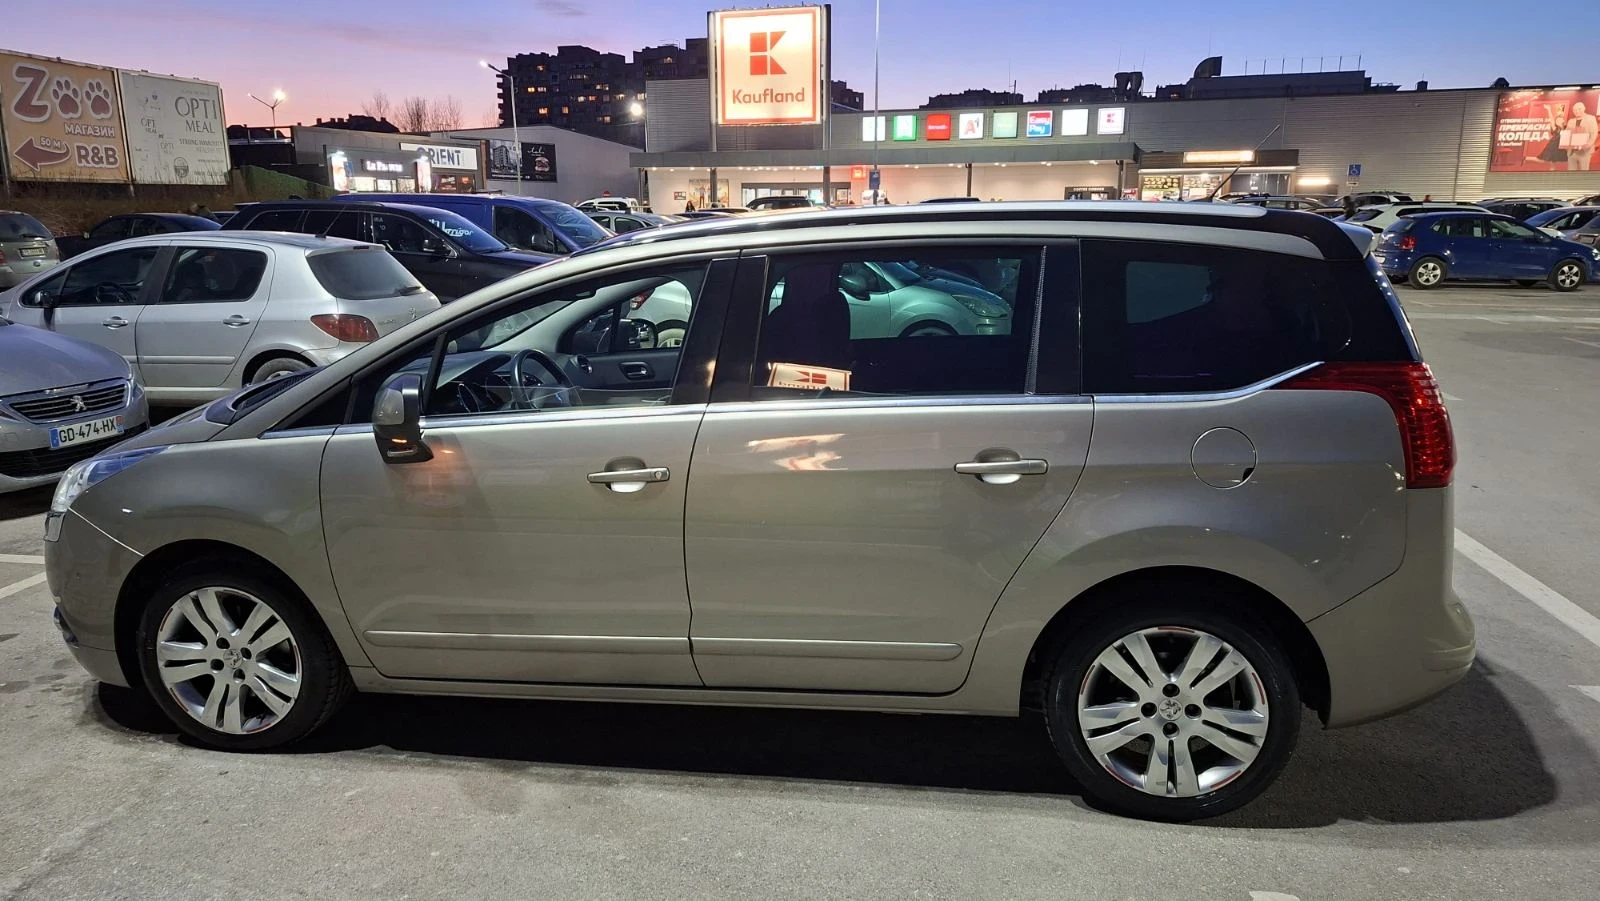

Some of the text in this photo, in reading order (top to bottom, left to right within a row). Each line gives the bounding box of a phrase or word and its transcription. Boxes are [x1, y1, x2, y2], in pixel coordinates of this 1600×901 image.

[732, 87, 805, 104] Kaufland
[175, 96, 218, 119] OPTI
[64, 122, 116, 138] МАГАЗИН
[186, 120, 216, 133] MEAL
[1499, 123, 1551, 131] ПРЕКРАСНА
[40, 136, 51, 147] 50
[1498, 131, 1550, 142] КОЛЕДА
[76, 144, 119, 167] R&B
[59, 418, 117, 443] GD-474-HX
